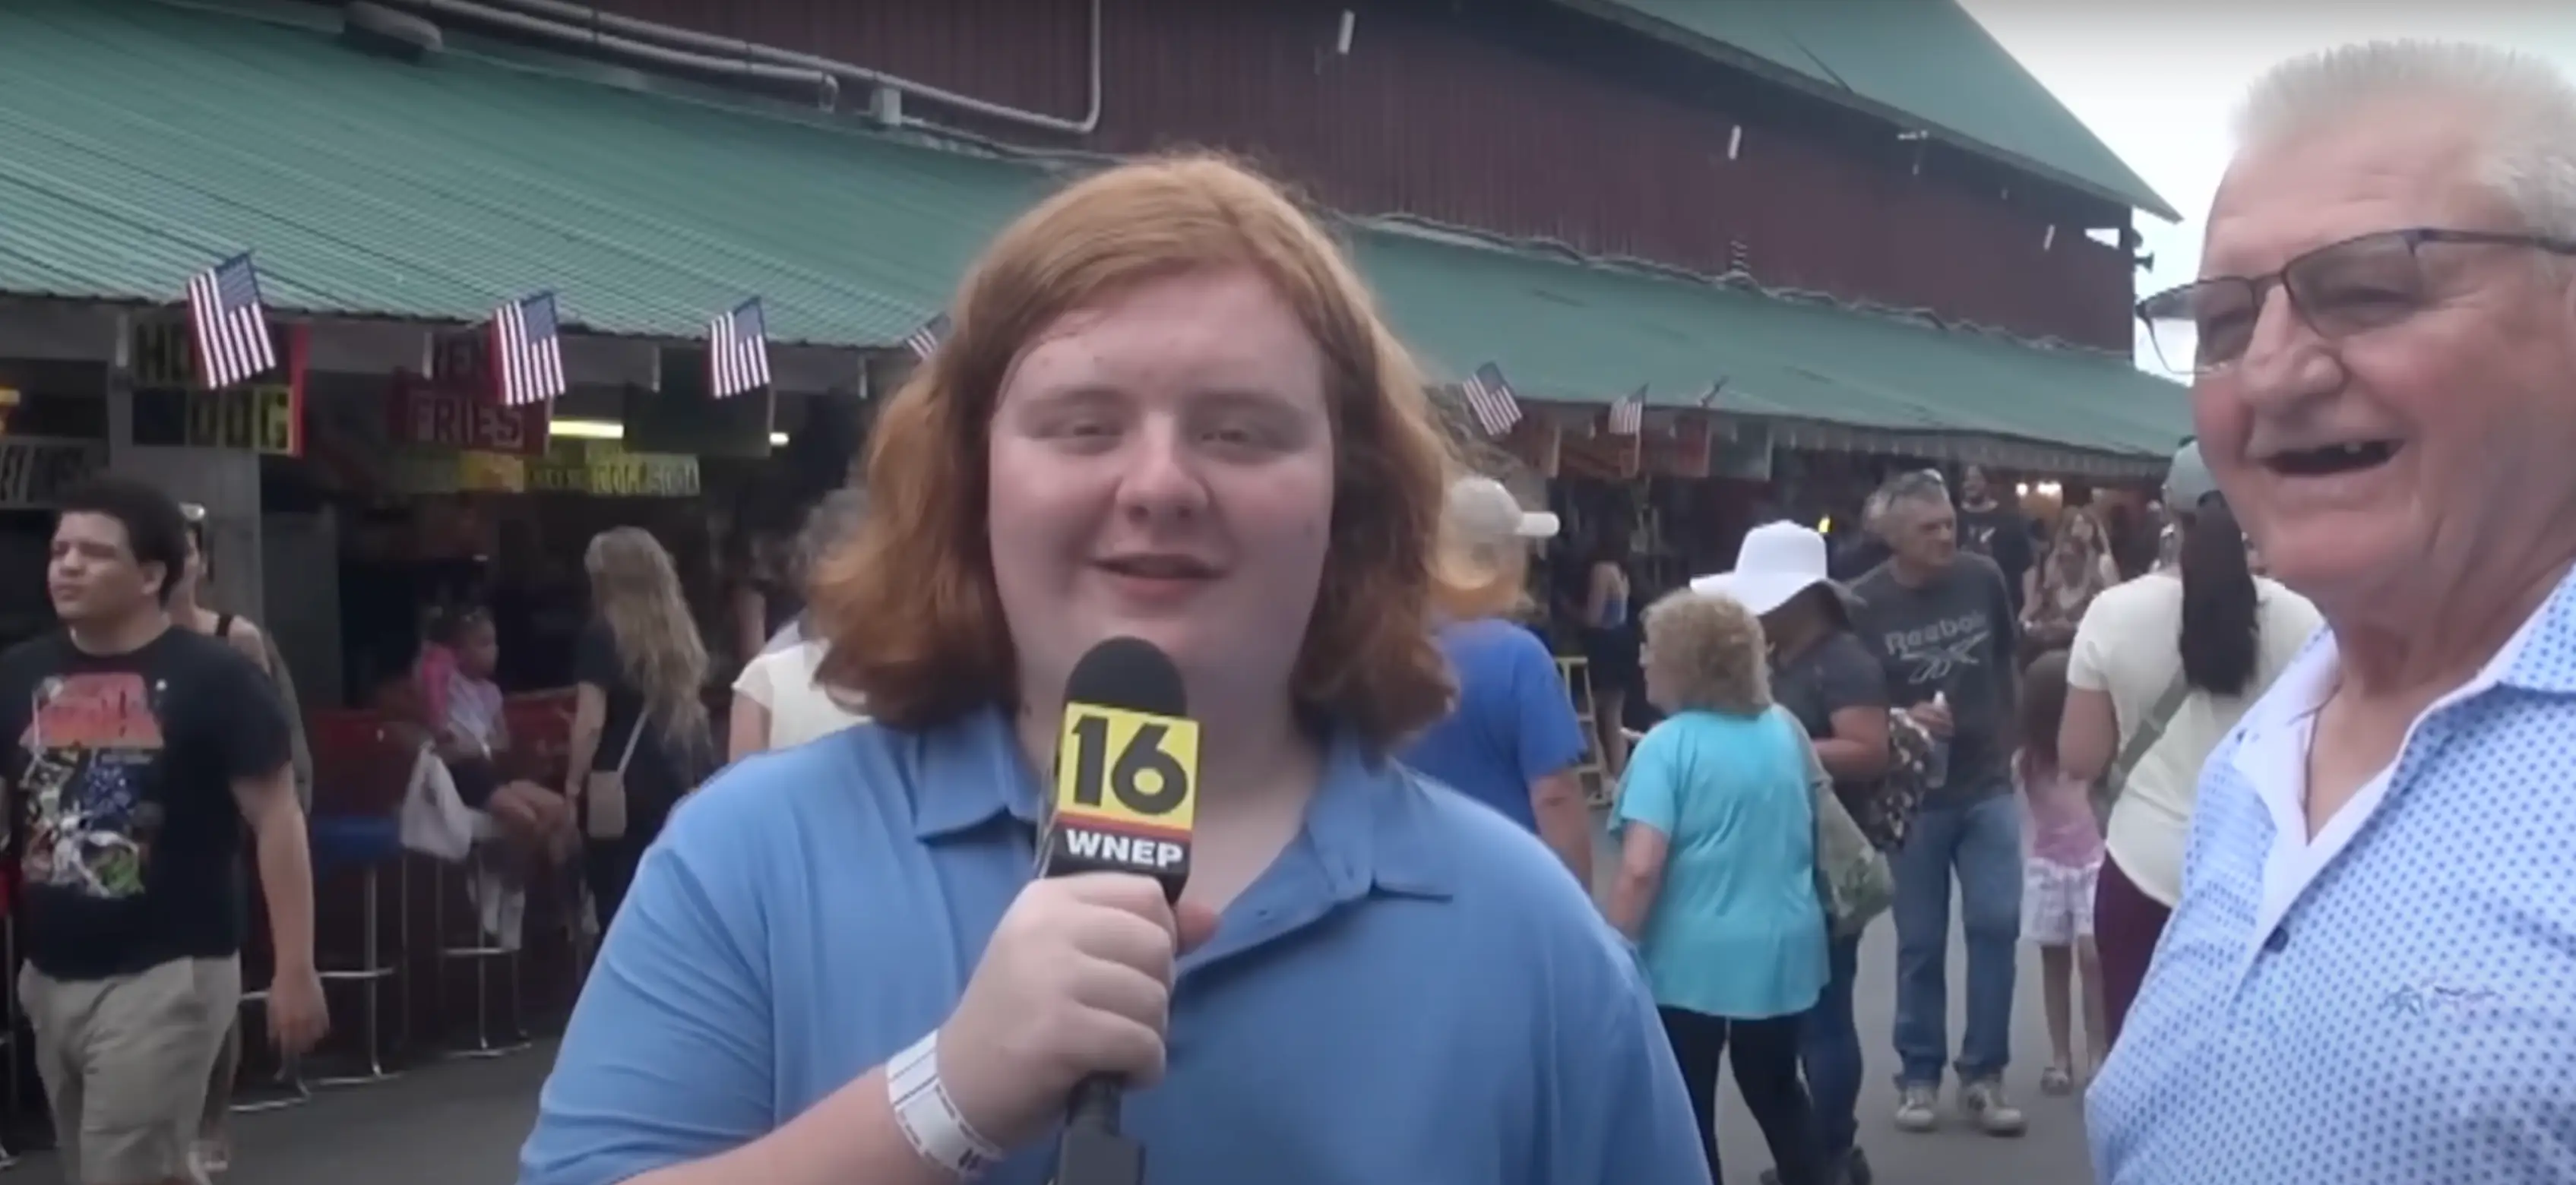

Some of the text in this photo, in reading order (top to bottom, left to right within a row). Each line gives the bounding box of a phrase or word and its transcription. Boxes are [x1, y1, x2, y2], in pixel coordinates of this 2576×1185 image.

[411, 393, 523, 447] FRIES
[1071, 713, 1189, 816] 16
[1065, 828, 1184, 867] WNEP
